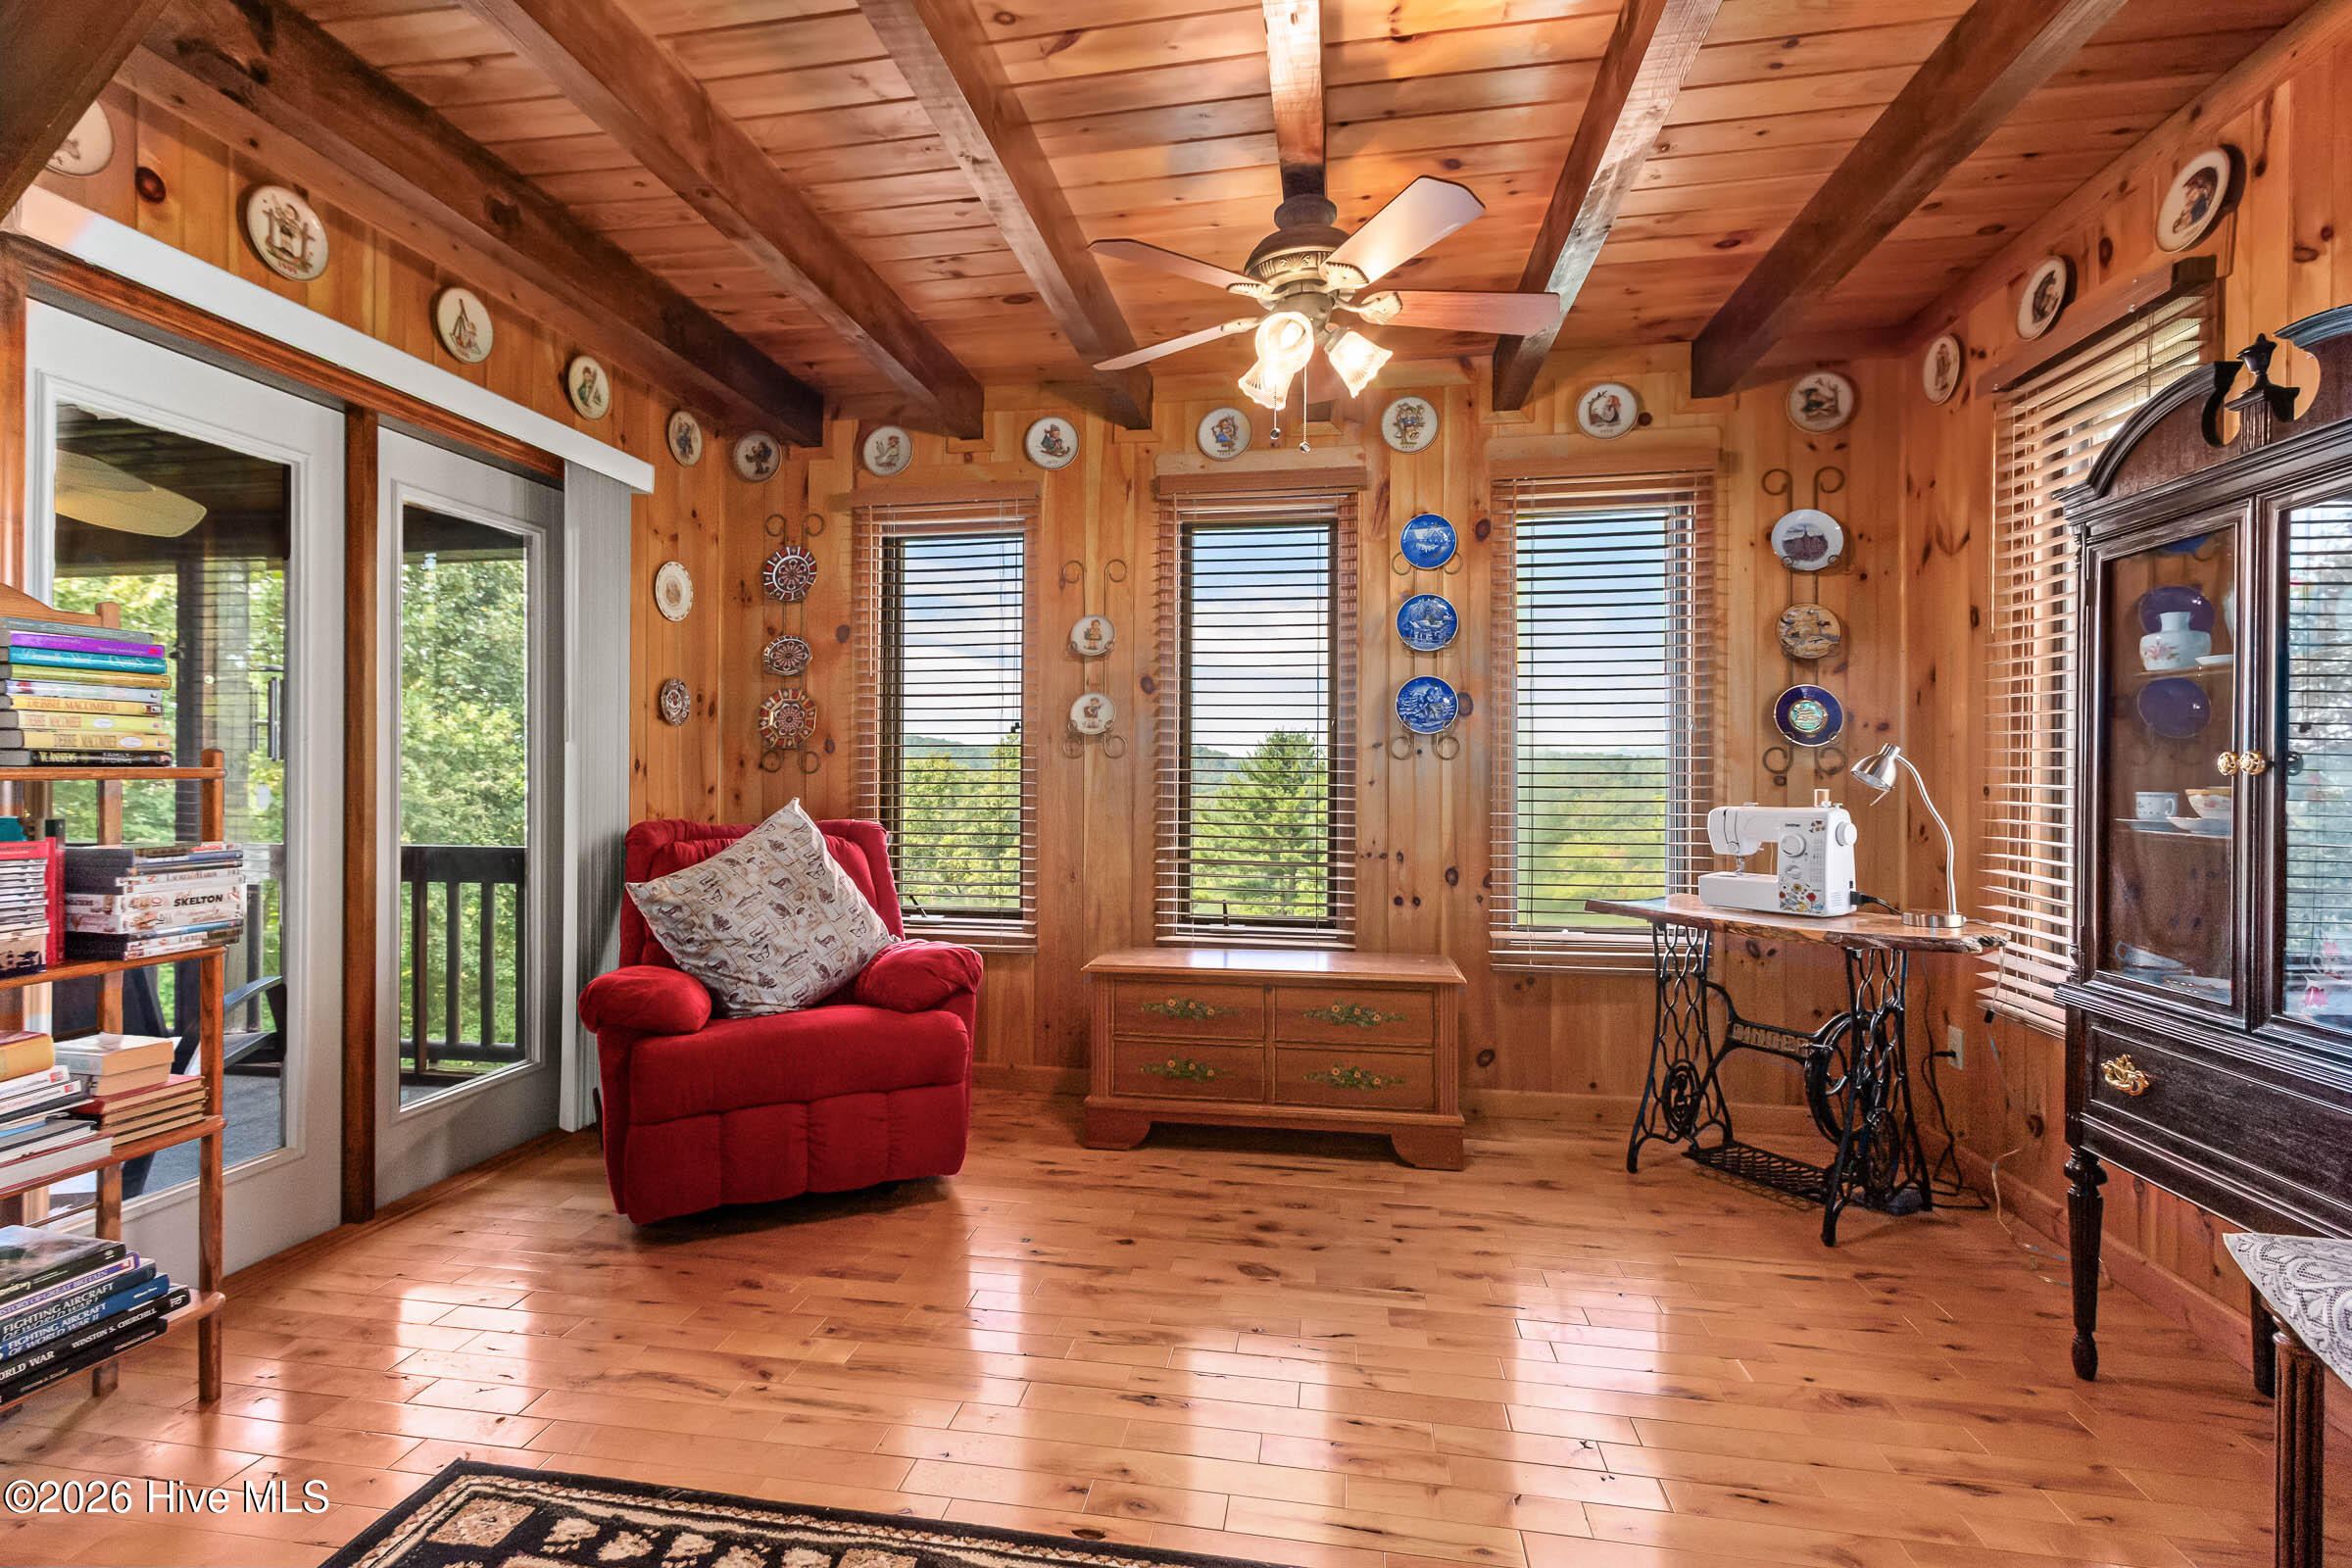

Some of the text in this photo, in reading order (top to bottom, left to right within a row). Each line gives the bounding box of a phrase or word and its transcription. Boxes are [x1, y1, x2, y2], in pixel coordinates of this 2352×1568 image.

[173, 894, 223, 908] SKELTON
[3, 1304, 61, 1335] FIGHTING
[63, 1282, 114, 1310] AIRCRAFT
[8, 1301, 107, 1349] FIGHTING AIRCRAFT
[0, 1362, 26, 1381] ORLD
[28, 1350, 56, 1367] WAR
[72, 1328, 108, 1348] WINSTON
[109, 1325, 117, 1334] S.
[118, 1307, 158, 1330] CHURCHILL
[8, 1313, 100, 1356] OF WORLD WAR II
